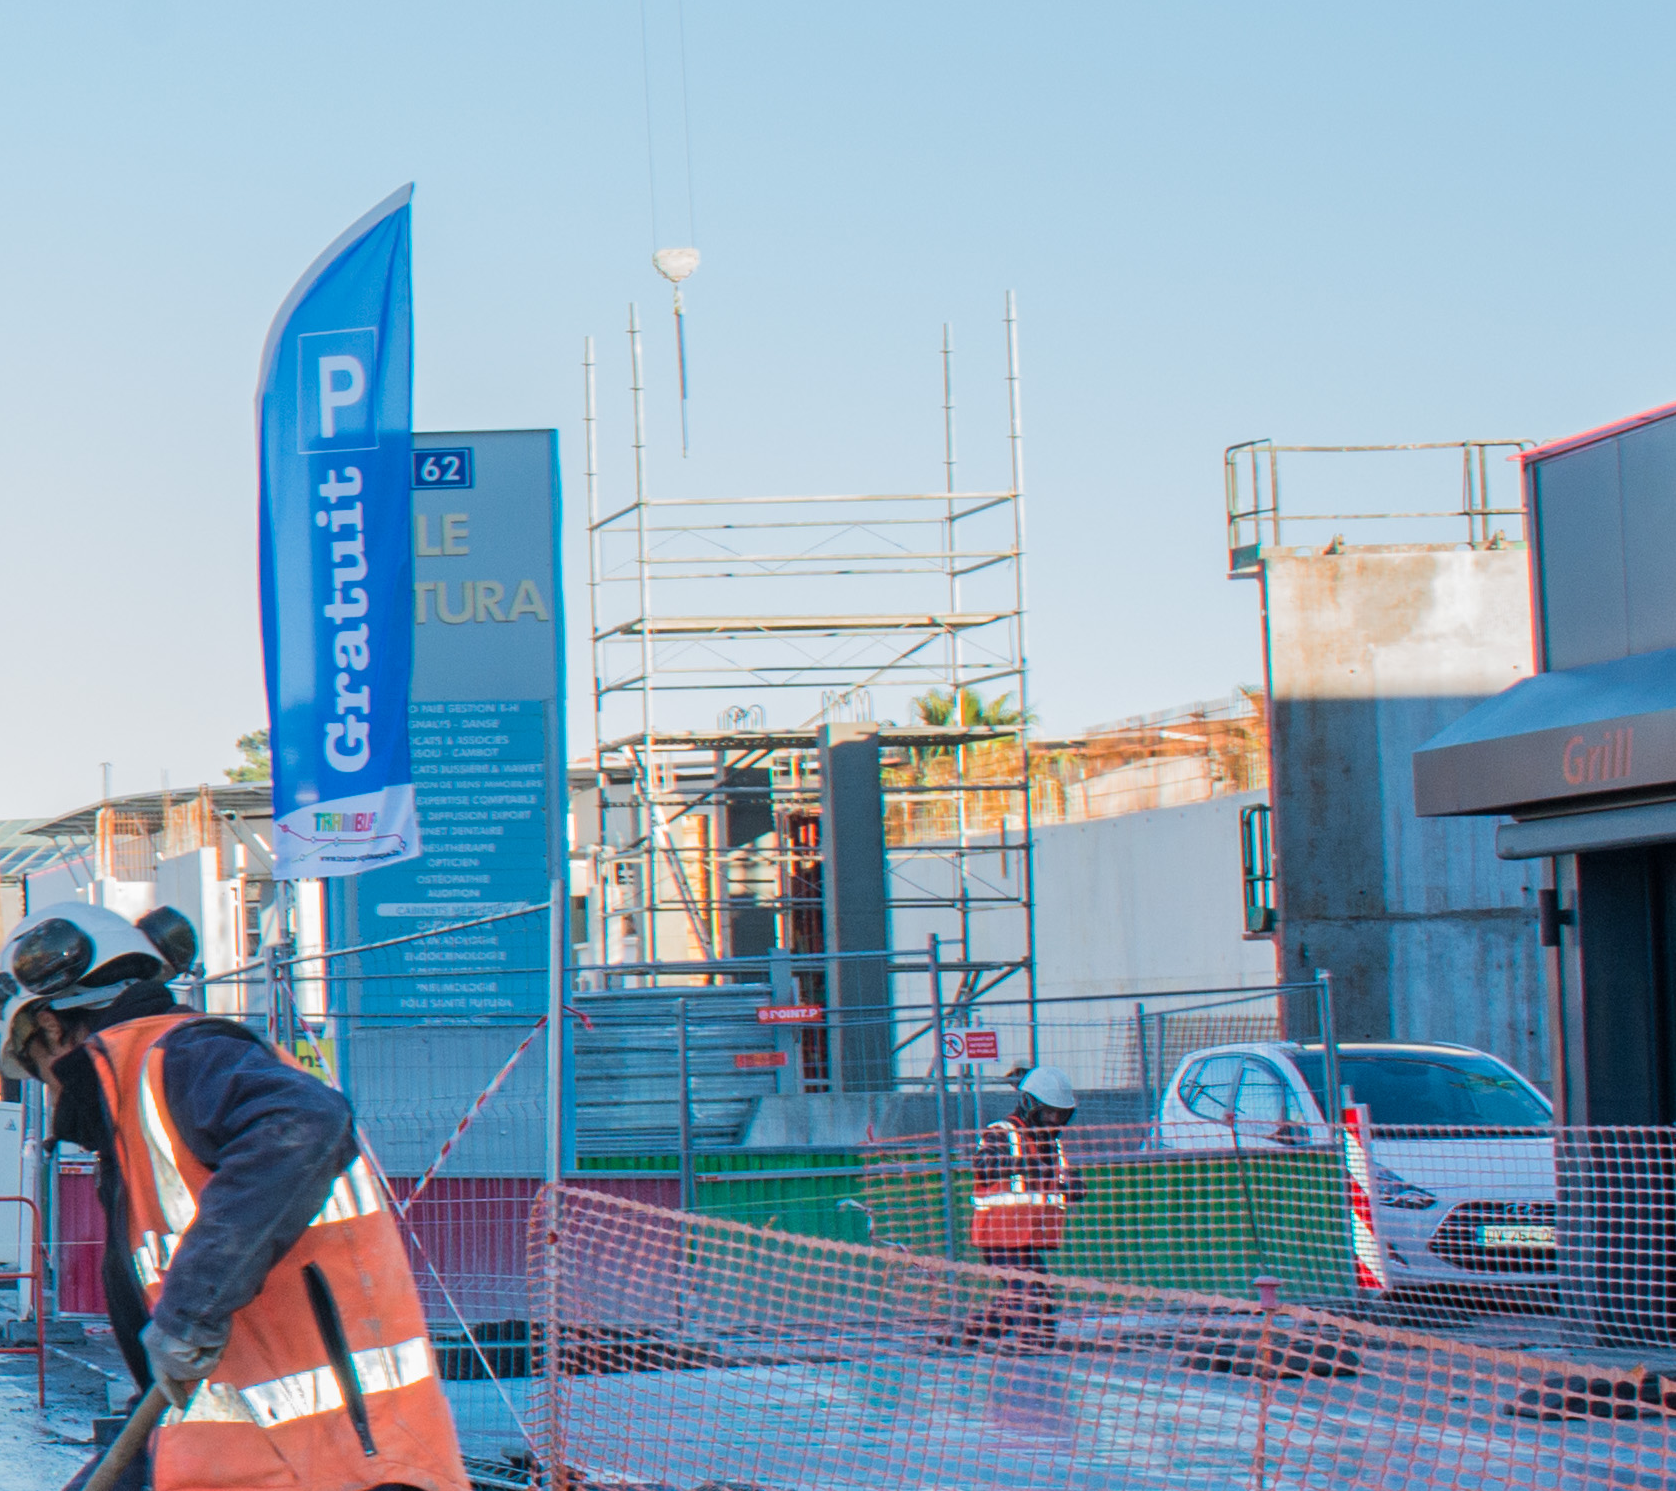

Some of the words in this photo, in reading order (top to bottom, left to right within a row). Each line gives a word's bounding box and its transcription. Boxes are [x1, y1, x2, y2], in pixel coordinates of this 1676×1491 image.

[319, 355, 366, 438] P
[420, 456, 461, 482] 62
[316, 465, 371, 773] Gratuit
[1563, 727, 1633, 784] Grill
